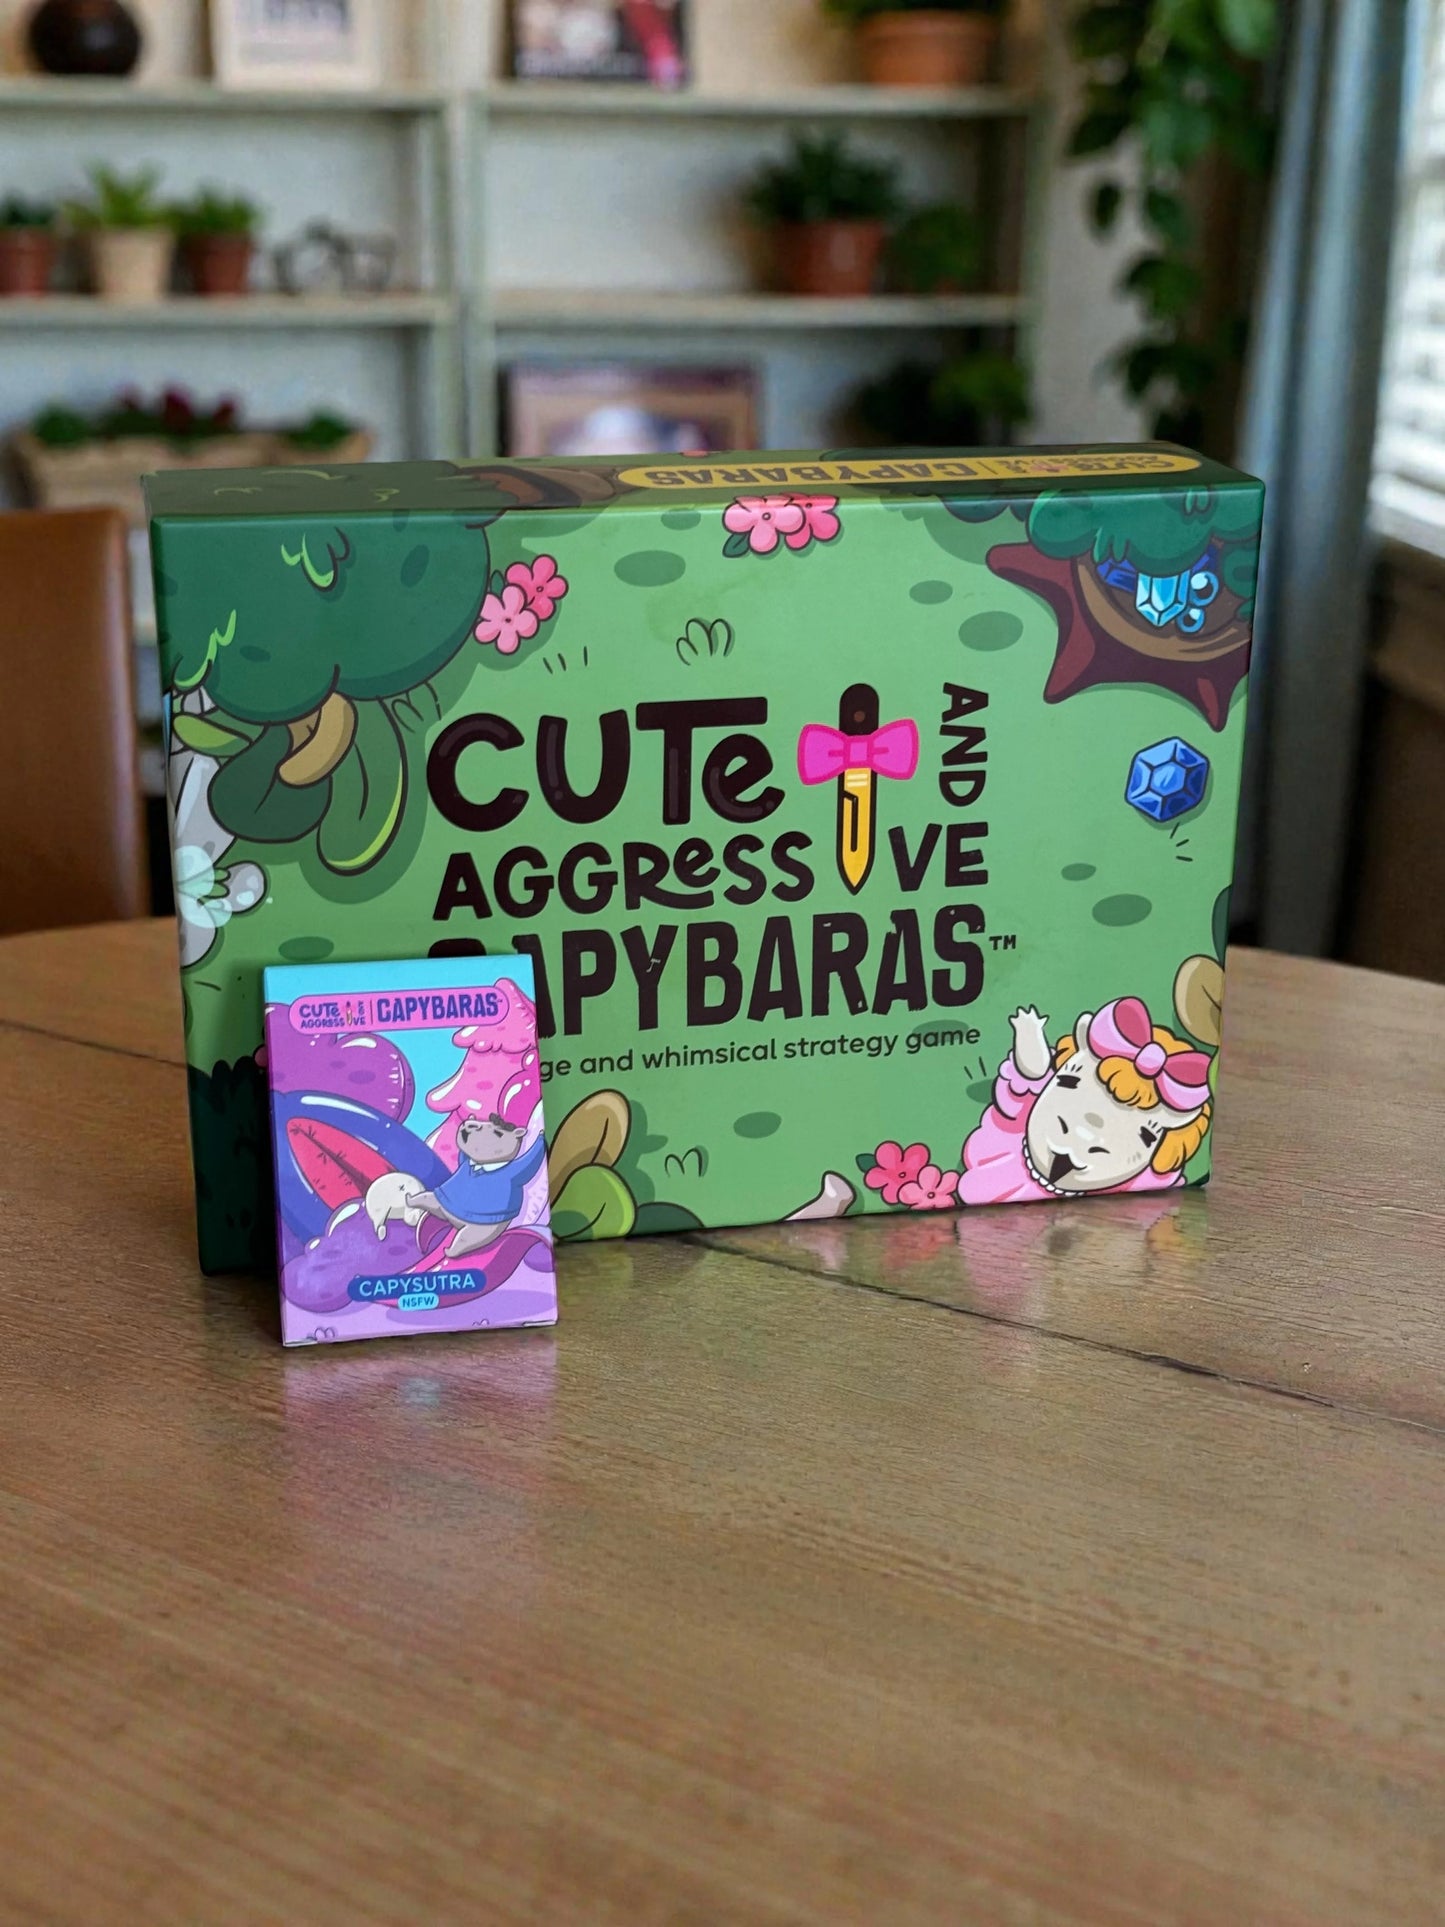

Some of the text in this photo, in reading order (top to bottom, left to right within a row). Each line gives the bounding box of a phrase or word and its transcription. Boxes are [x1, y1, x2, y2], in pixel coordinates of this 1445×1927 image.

[645, 461, 979, 486] CAPYBARAS
[938, 682, 990, 807] AND
[376, 992, 499, 1023] CAPYBARAS
[579, 1050, 634, 1074] and
[643, 1038, 778, 1069] whimsical
[783, 1033, 899, 1059] strategy
[905, 1027, 982, 1055] game
[359, 1272, 477, 1297] CAPYSUTRA
[402, 1296, 435, 1308] NSFW
